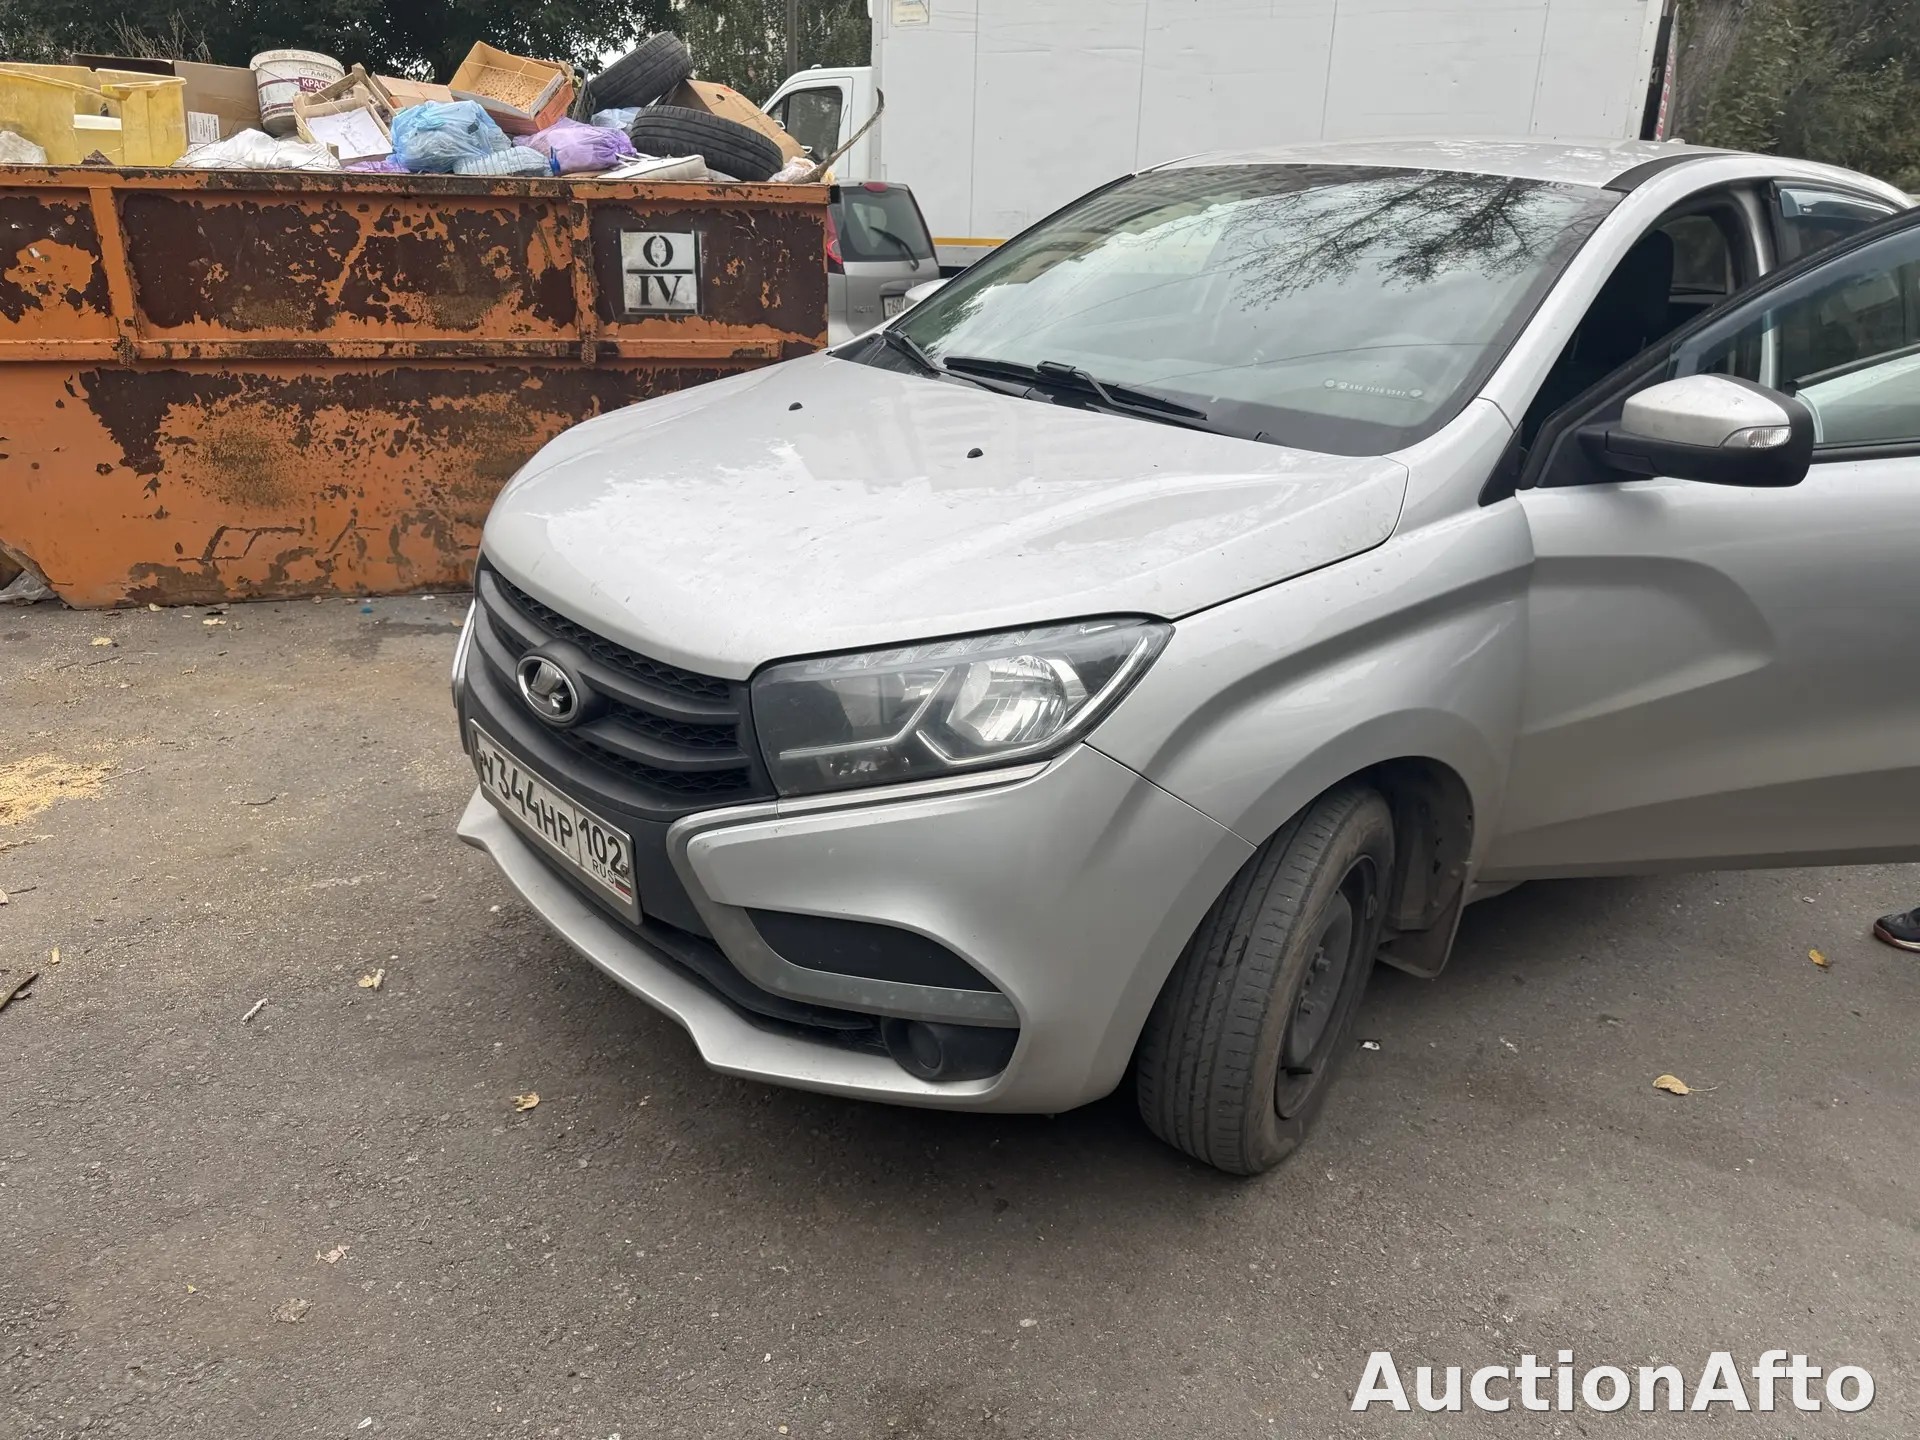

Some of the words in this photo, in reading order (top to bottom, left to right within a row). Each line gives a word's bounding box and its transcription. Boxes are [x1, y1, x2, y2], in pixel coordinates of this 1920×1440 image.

[639, 276, 682, 305] IV
[579, 817, 628, 877] 102
[592, 859, 615, 885] RUS
